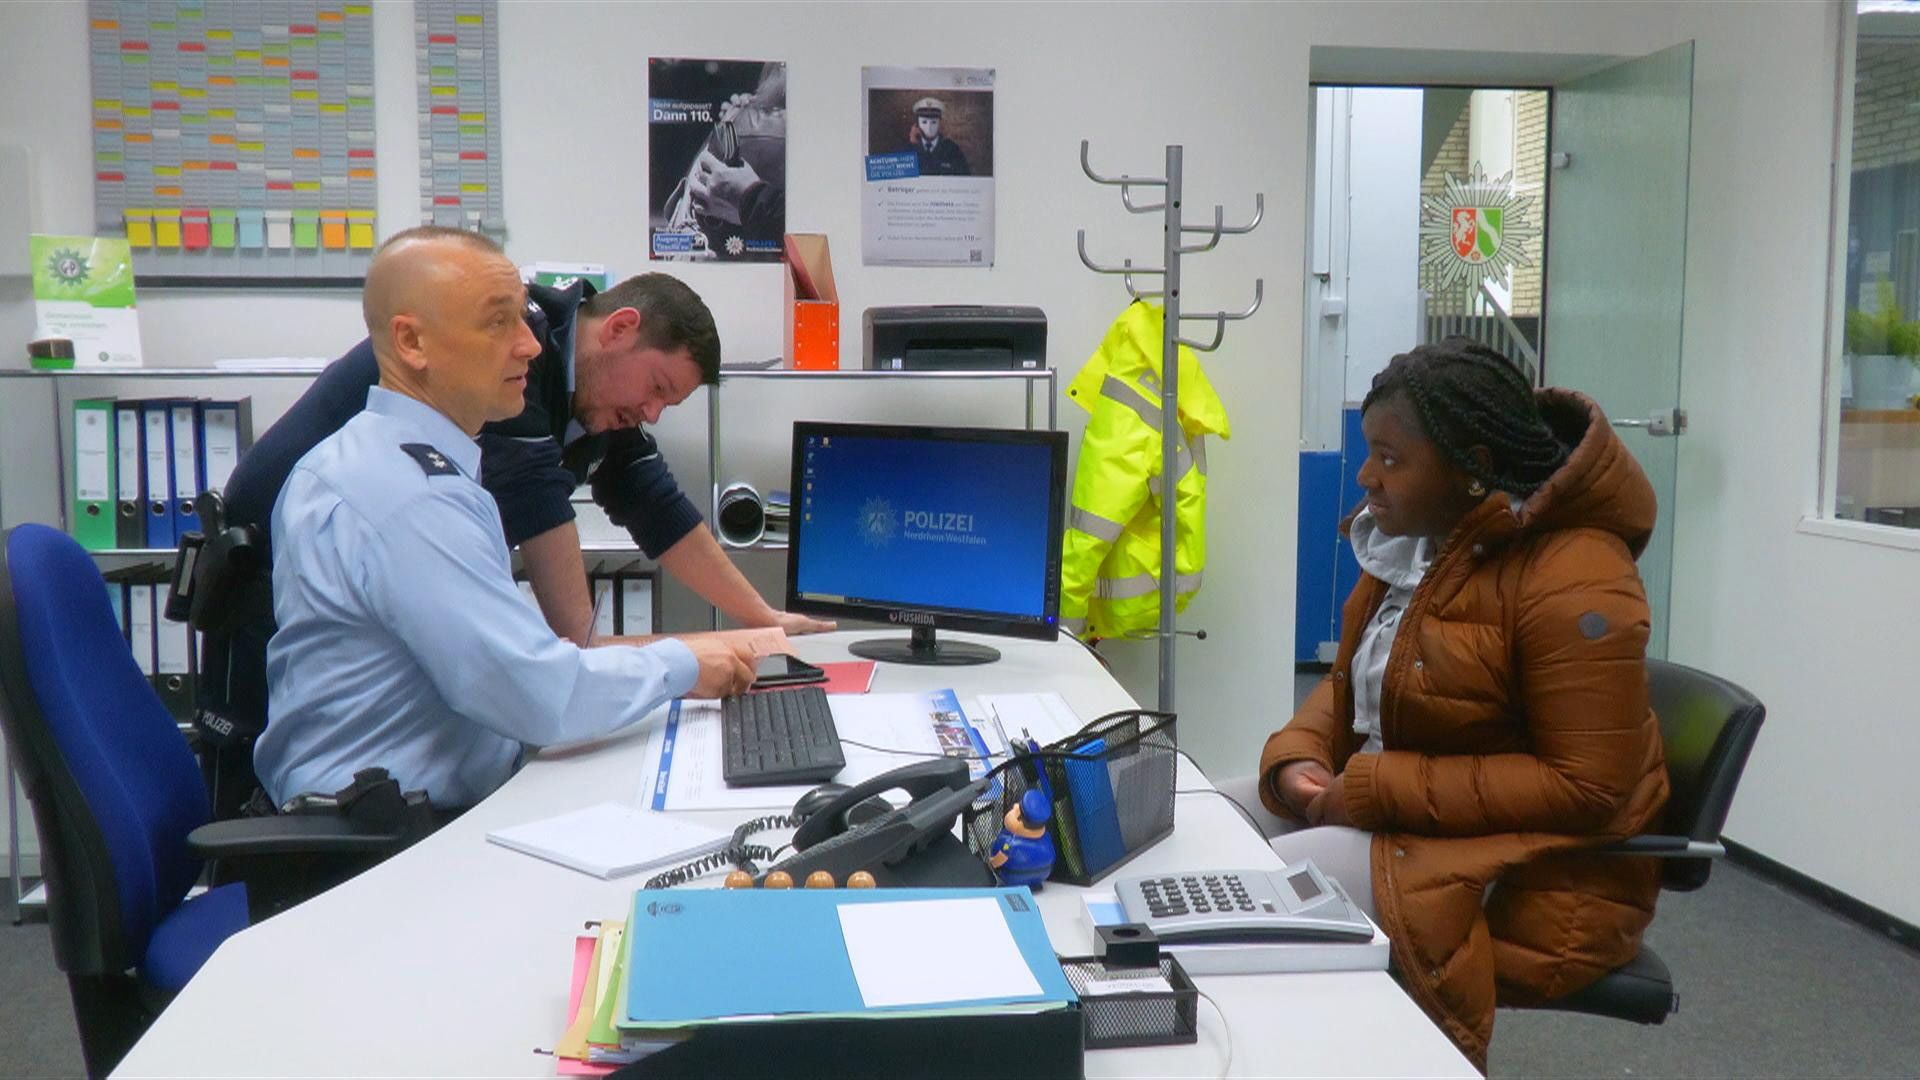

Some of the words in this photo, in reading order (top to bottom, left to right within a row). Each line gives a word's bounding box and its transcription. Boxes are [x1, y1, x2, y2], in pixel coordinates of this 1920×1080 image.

[653, 109, 688, 121] Dann
[690, 110, 714, 122] 110.
[903, 510, 974, 532] POLIZEI
[899, 611, 935, 625] FUSHIDA
